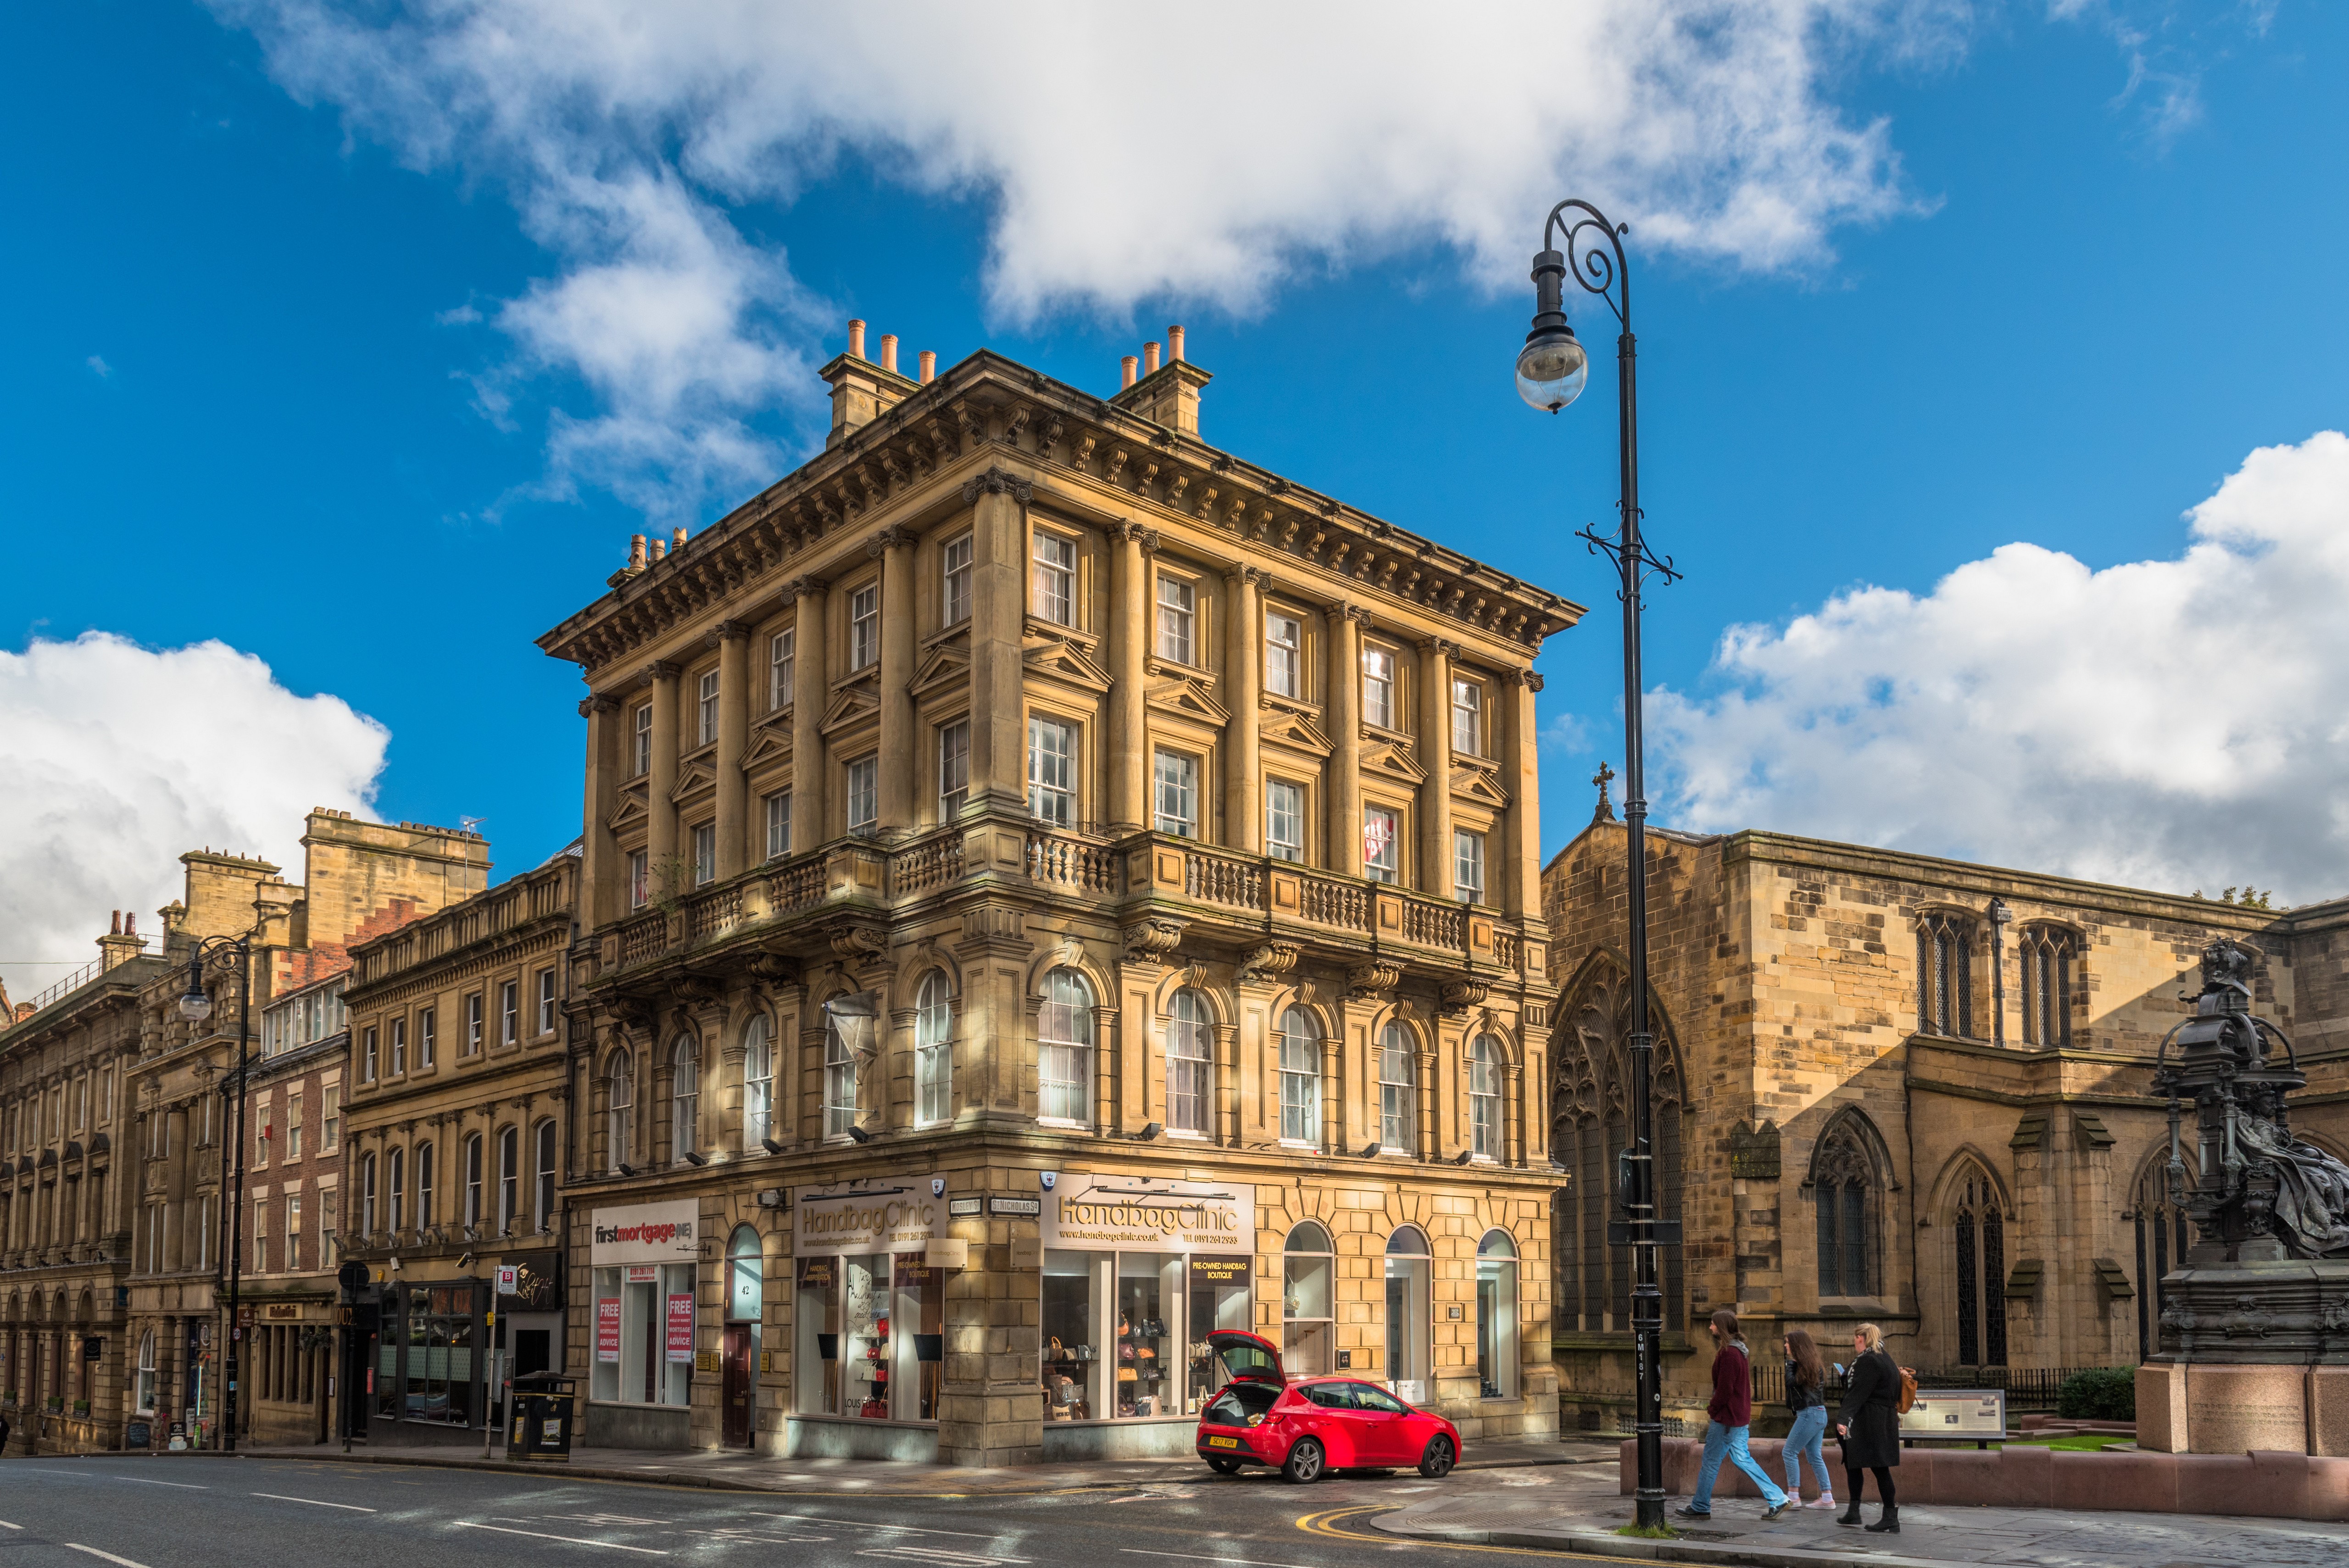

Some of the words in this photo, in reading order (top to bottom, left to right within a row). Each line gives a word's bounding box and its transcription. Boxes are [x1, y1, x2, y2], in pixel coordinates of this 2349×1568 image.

[952, 1201, 974, 1212] MOSLEY
[1000, 1201, 1030, 1211] NICHOLAS
[803, 1198, 934, 1235] HandbagClinic
[1059, 1195, 1238, 1235] HandbagClinic
[804, 1235, 870, 1247] www.handbagclinic.co.uk
[888, 1233, 897, 1242] TEL
[897, 1232, 909, 1242] 0191
[910, 1231, 919, 1241] 261
[920, 1230, 934, 1240] 2933
[1060, 1230, 1158, 1242] www.handbagclinic.co.uk
[1183, 1234, 1193, 1243] TEL
[1195, 1234, 1209, 1243] 0191
[1210, 1234, 1221, 1244] 261
[1221, 1235, 1238, 1244] 2933
[630, 1267, 639, 1275] 0191
[646, 1267, 655, 1275] 7114
[909, 1269, 930, 1278] BOUTIQUE
[742, 1286, 749, 1295] 42
[601, 1304, 619, 1317] FREE
[670, 1300, 690, 1314] FREE
[600, 1338, 618, 1346] ADVICE
[669, 1337, 690, 1346] ADVICE
[845, 1399, 860, 1408] LOUIS
